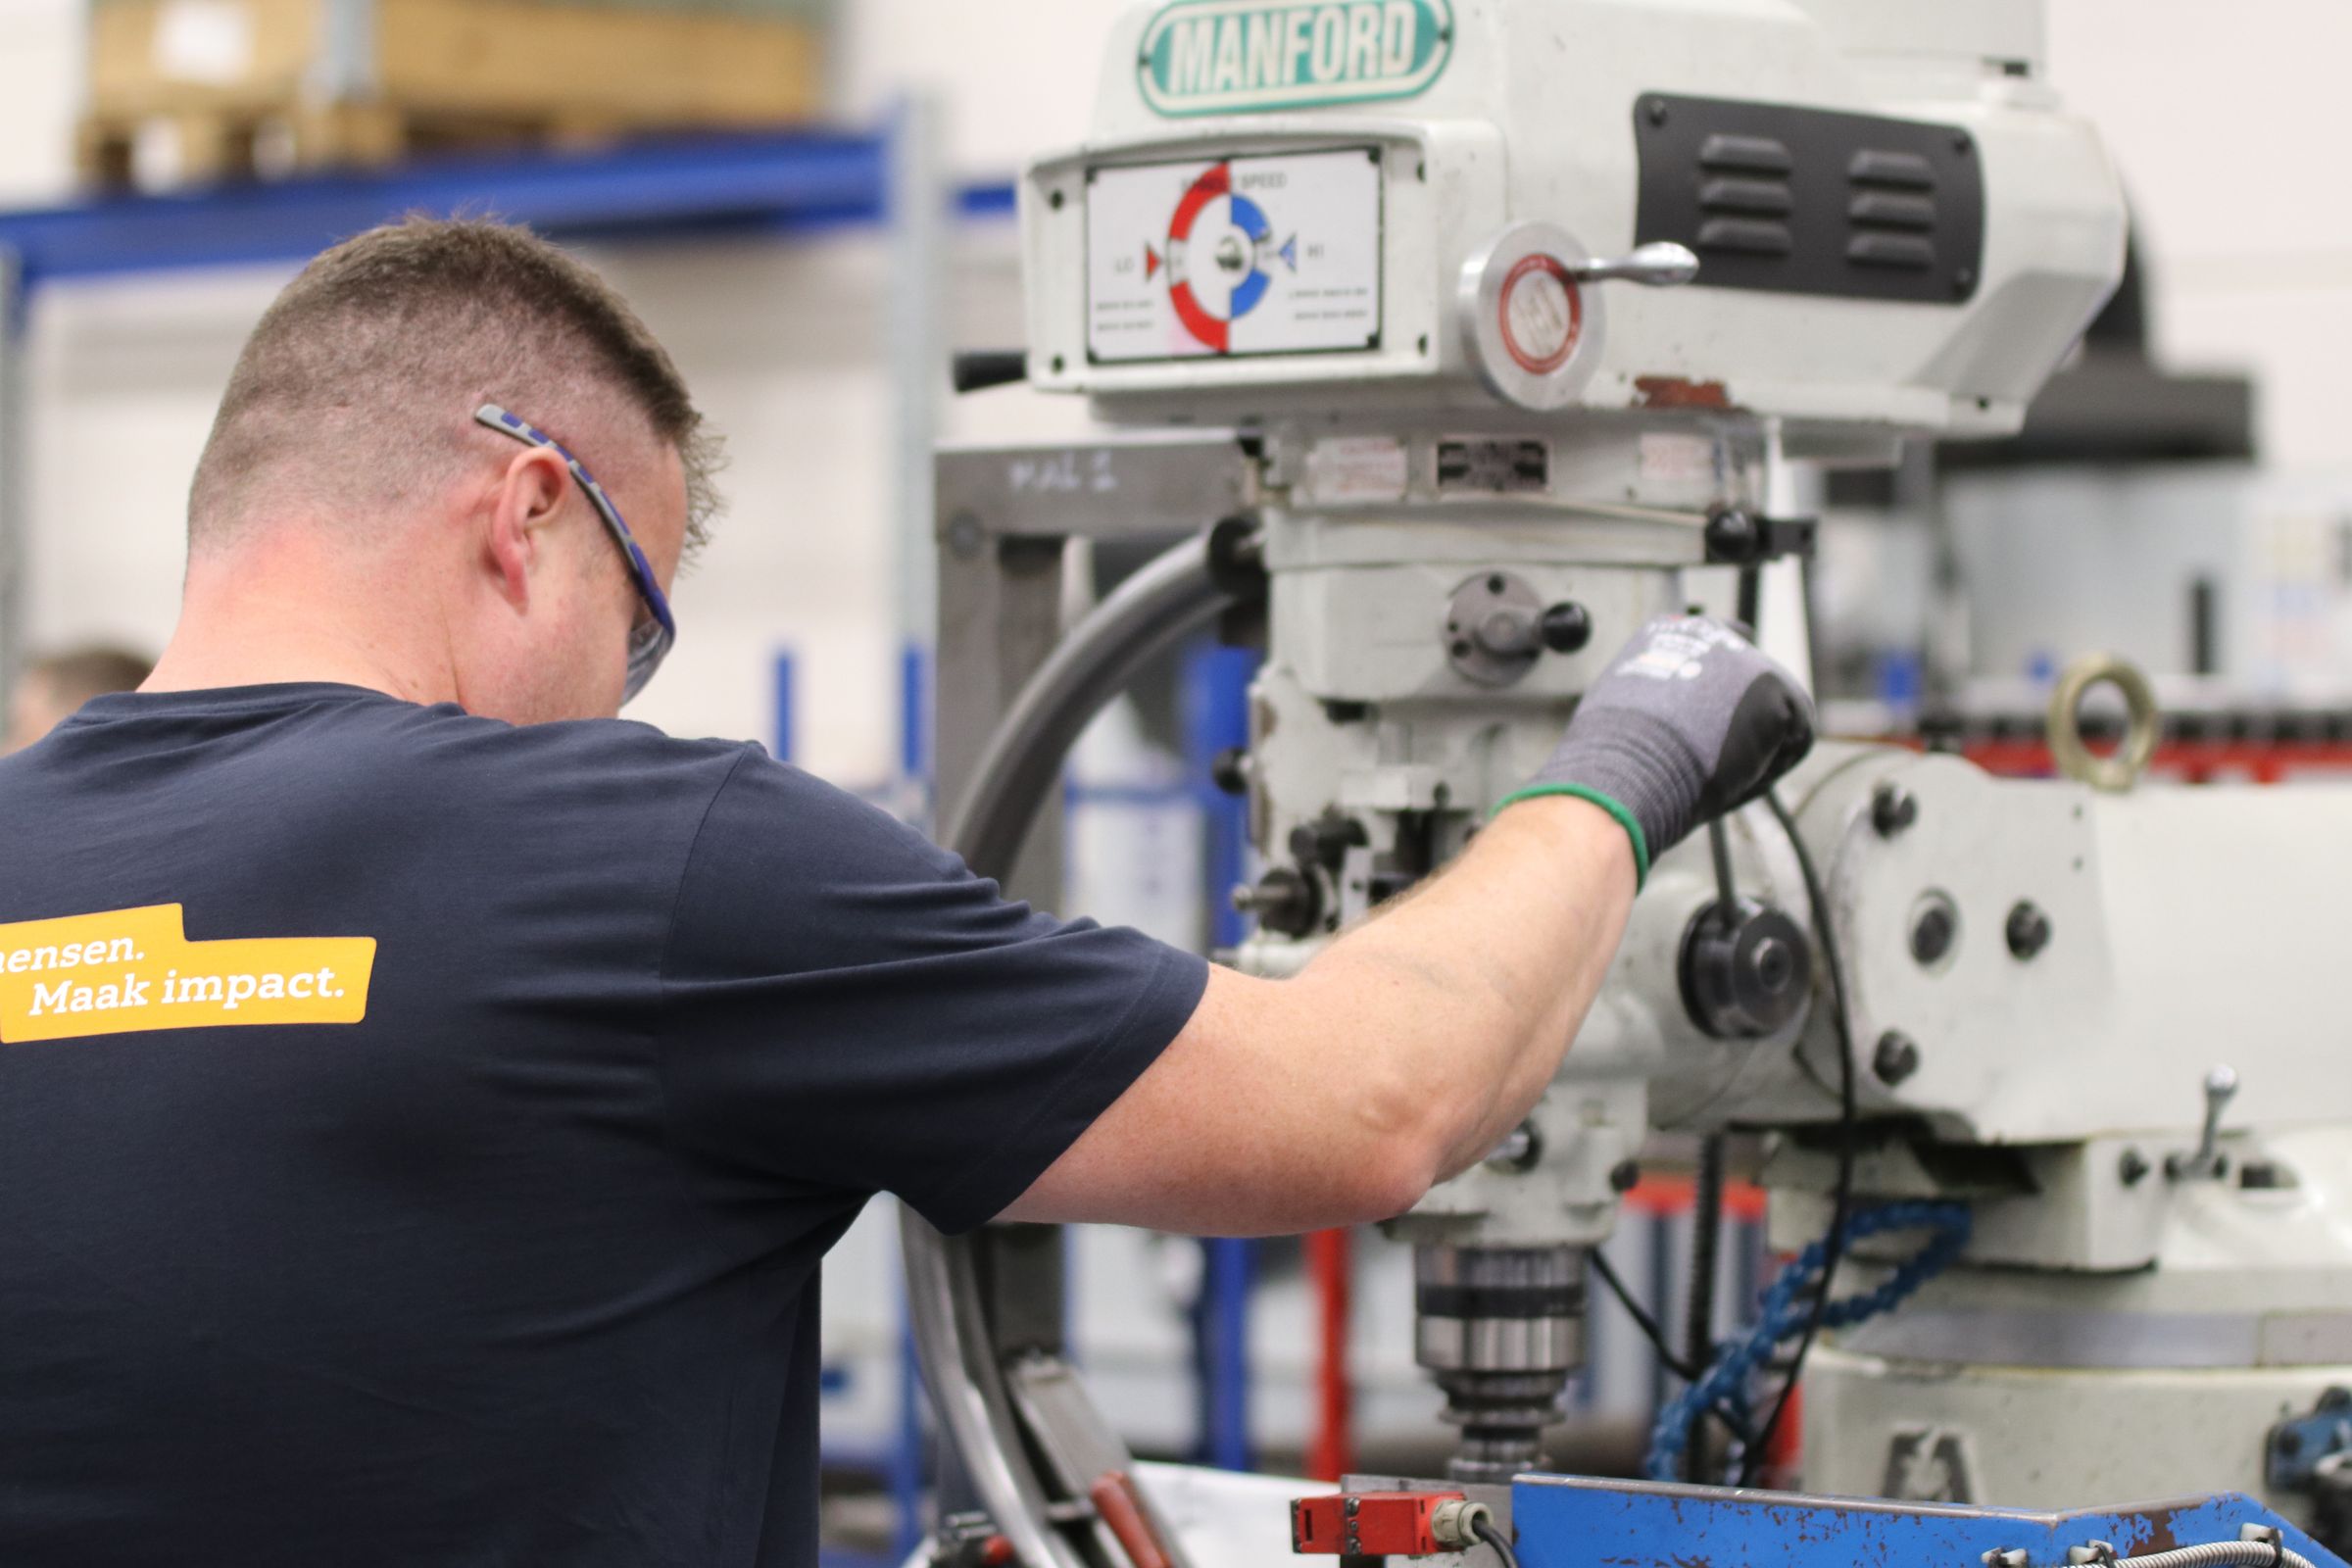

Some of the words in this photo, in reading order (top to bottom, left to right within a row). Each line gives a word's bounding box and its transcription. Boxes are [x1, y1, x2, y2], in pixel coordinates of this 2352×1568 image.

[1166, 1, 1418, 95] MANFORD
[1241, 172, 1287, 189] SPEED
[28, 973, 150, 1016] Maak
[161, 967, 345, 1009] impact.
